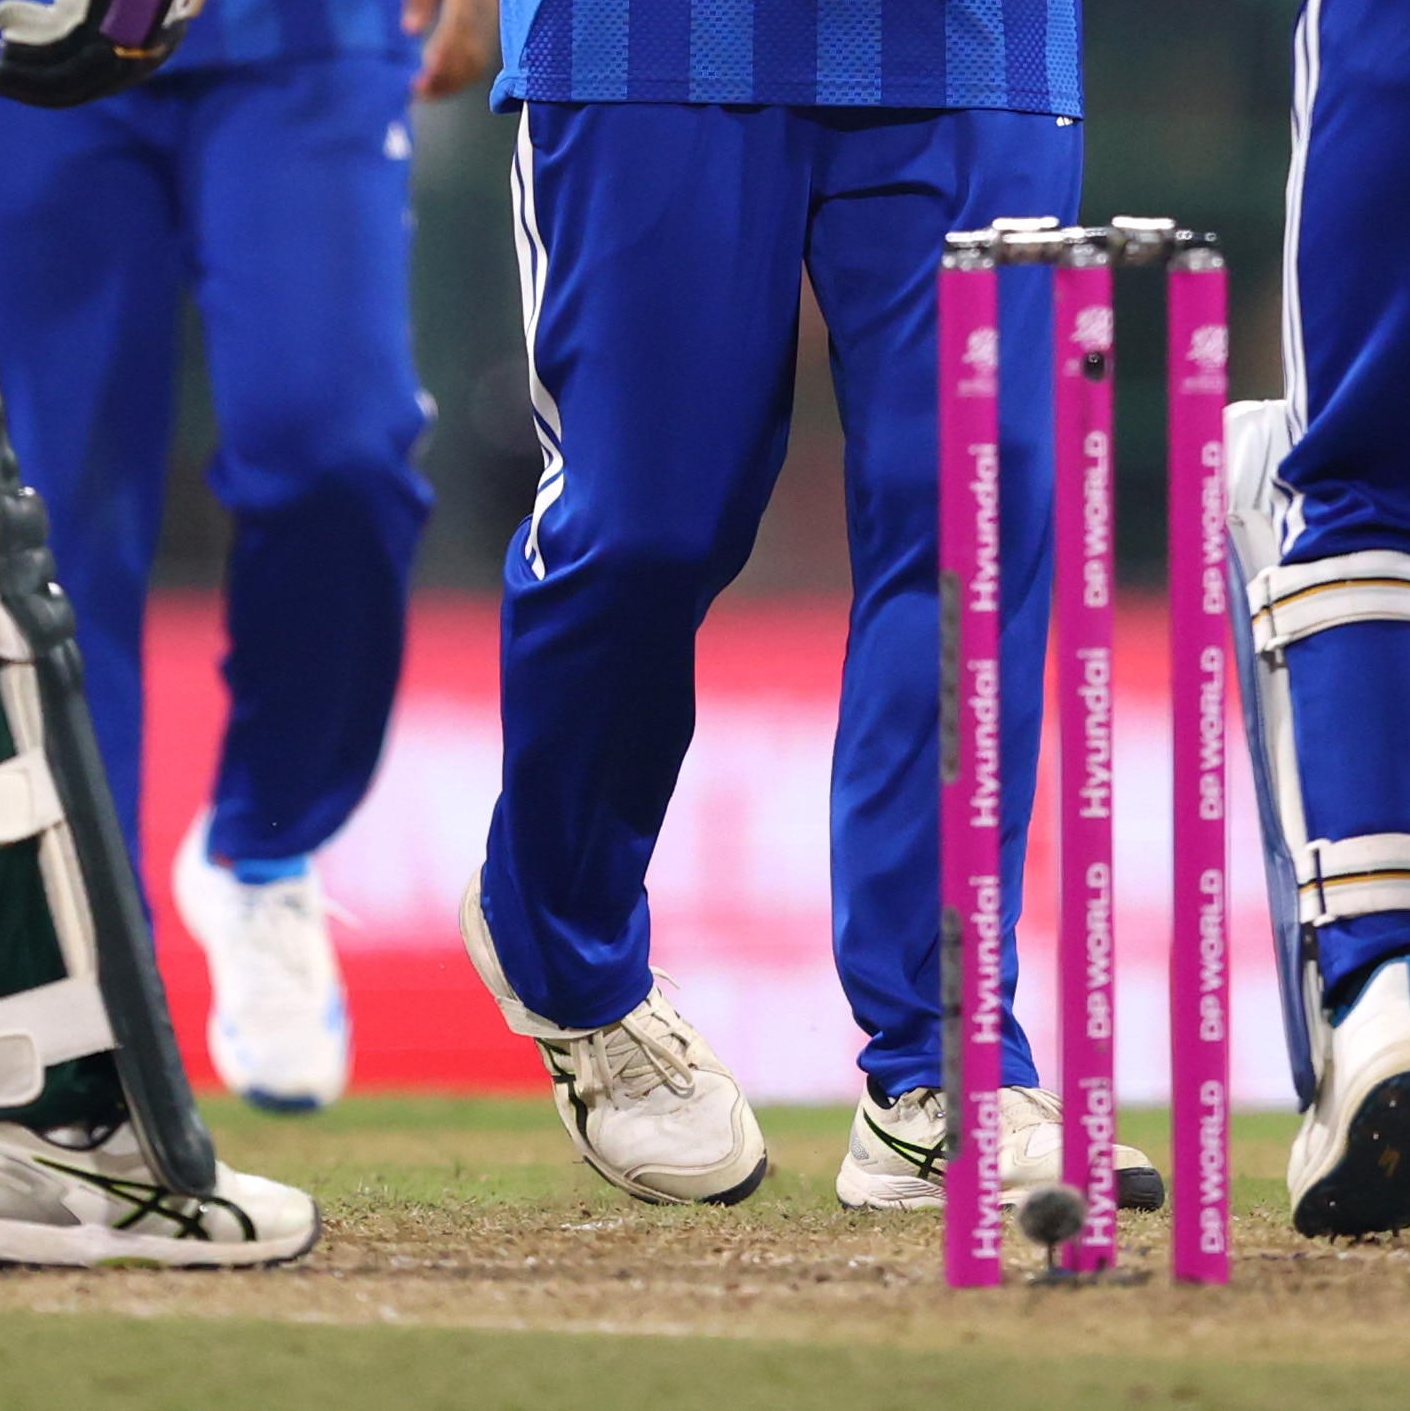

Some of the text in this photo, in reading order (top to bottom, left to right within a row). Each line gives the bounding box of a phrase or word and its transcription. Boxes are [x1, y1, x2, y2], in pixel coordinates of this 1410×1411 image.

[968, 443, 999, 612] Hyundai
[1084, 431, 1108, 608] DP WORLD
[1201, 441, 1226, 615] DP WORLD
[967, 659, 999, 827] Hyundai
[1077, 647, 1111, 818] Hyundai
[1200, 646, 1224, 820] DP WORLD
[969, 875, 1001, 1043] Hyundai
[1086, 862, 1111, 1039] DP WORLD
[1200, 869, 1224, 1041] DP WORLD
[970, 1092, 999, 1259] Hyundai
[1079, 1077, 1115, 1246] Hyundai
[1200, 1080, 1225, 1254] DP WORLD
